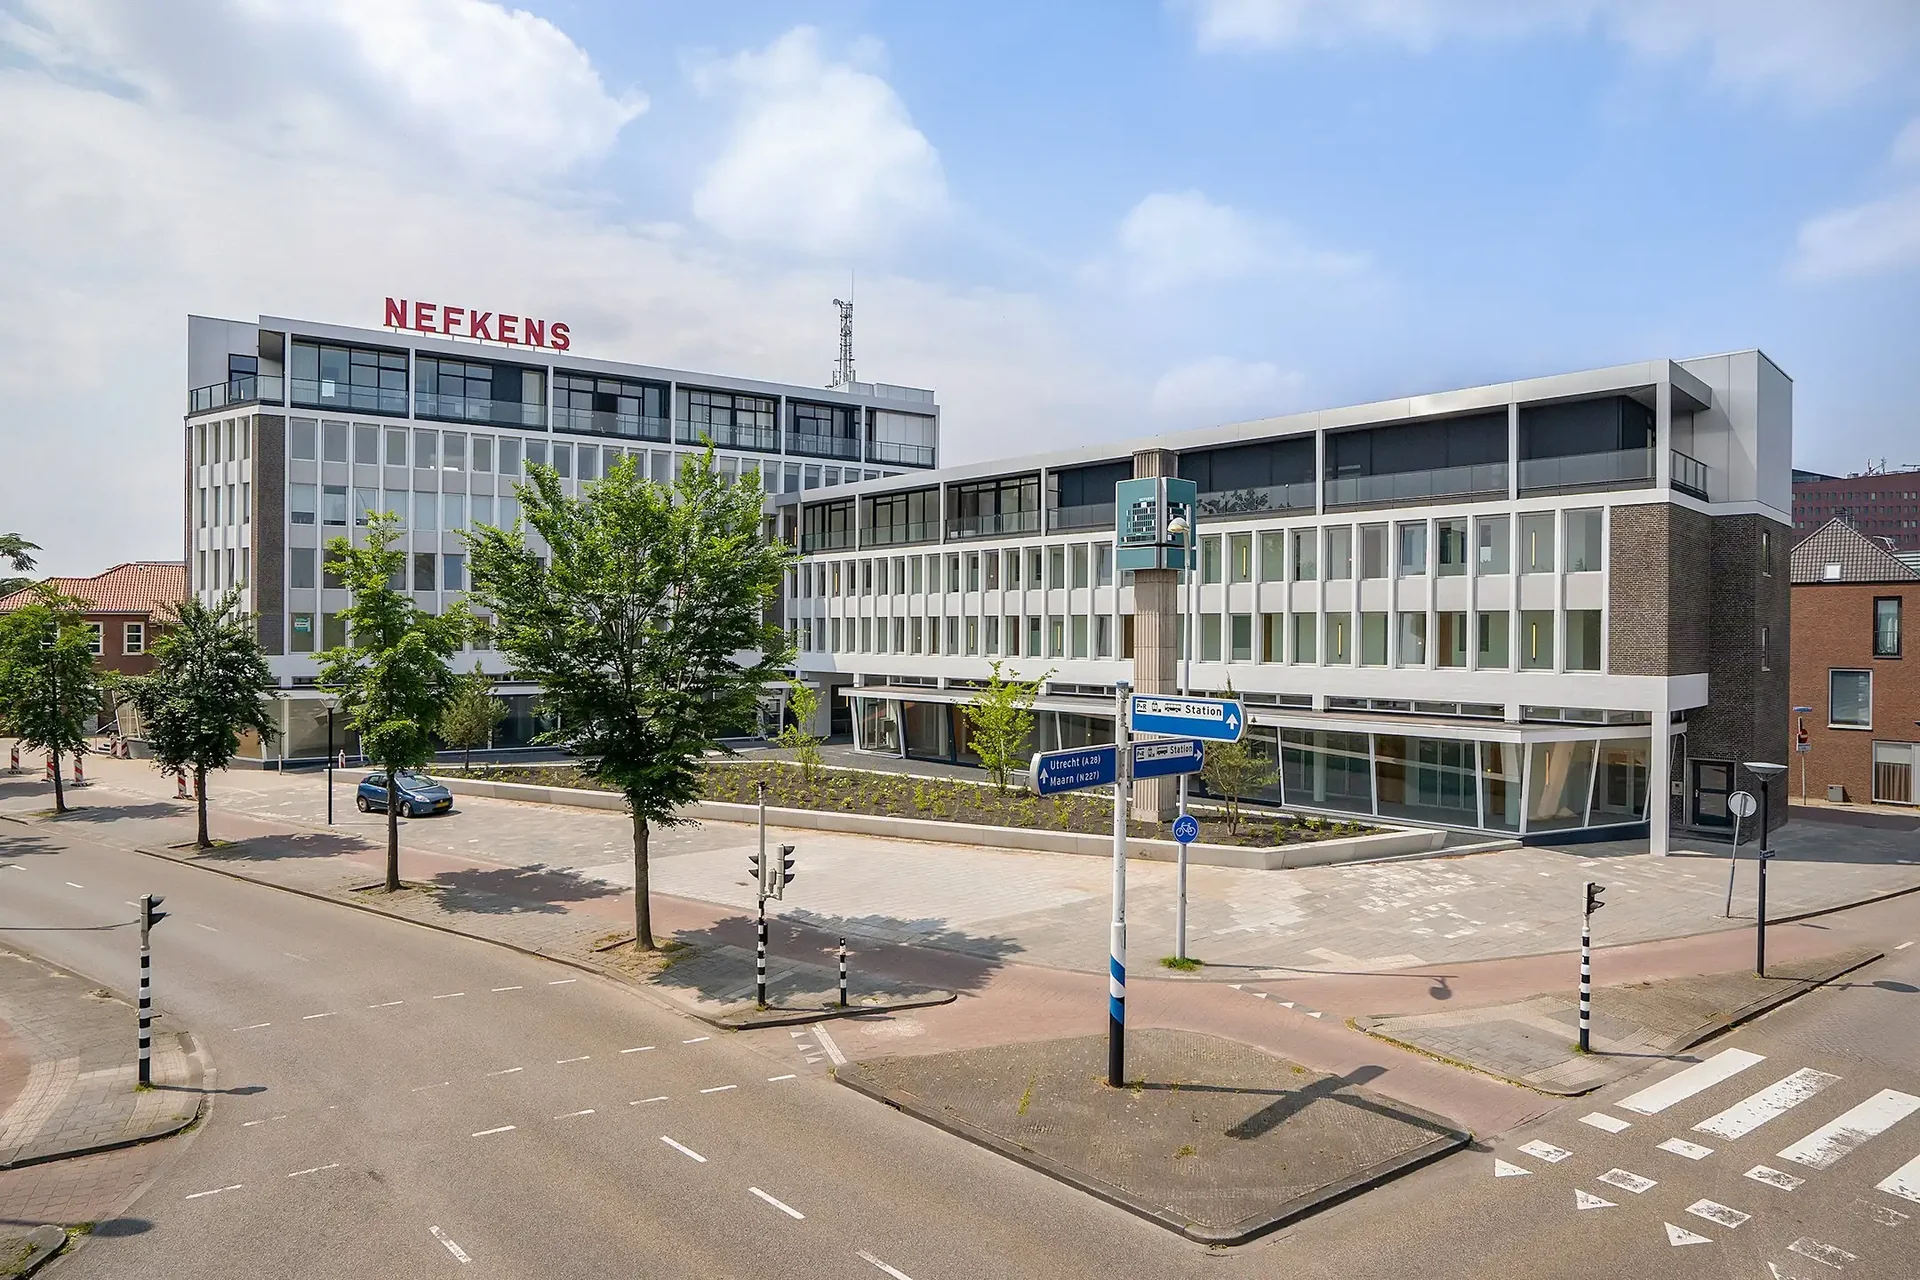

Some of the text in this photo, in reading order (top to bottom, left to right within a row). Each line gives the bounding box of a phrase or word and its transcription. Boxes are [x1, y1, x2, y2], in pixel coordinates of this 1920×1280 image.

[385, 296, 570, 350] NEFKENS
[1185, 704, 1222, 716] Station
[1170, 745, 1192, 754] Station
[1050, 758, 1080, 770] Utrecht
[1050, 770, 1100, 787] Maarn (N227)
